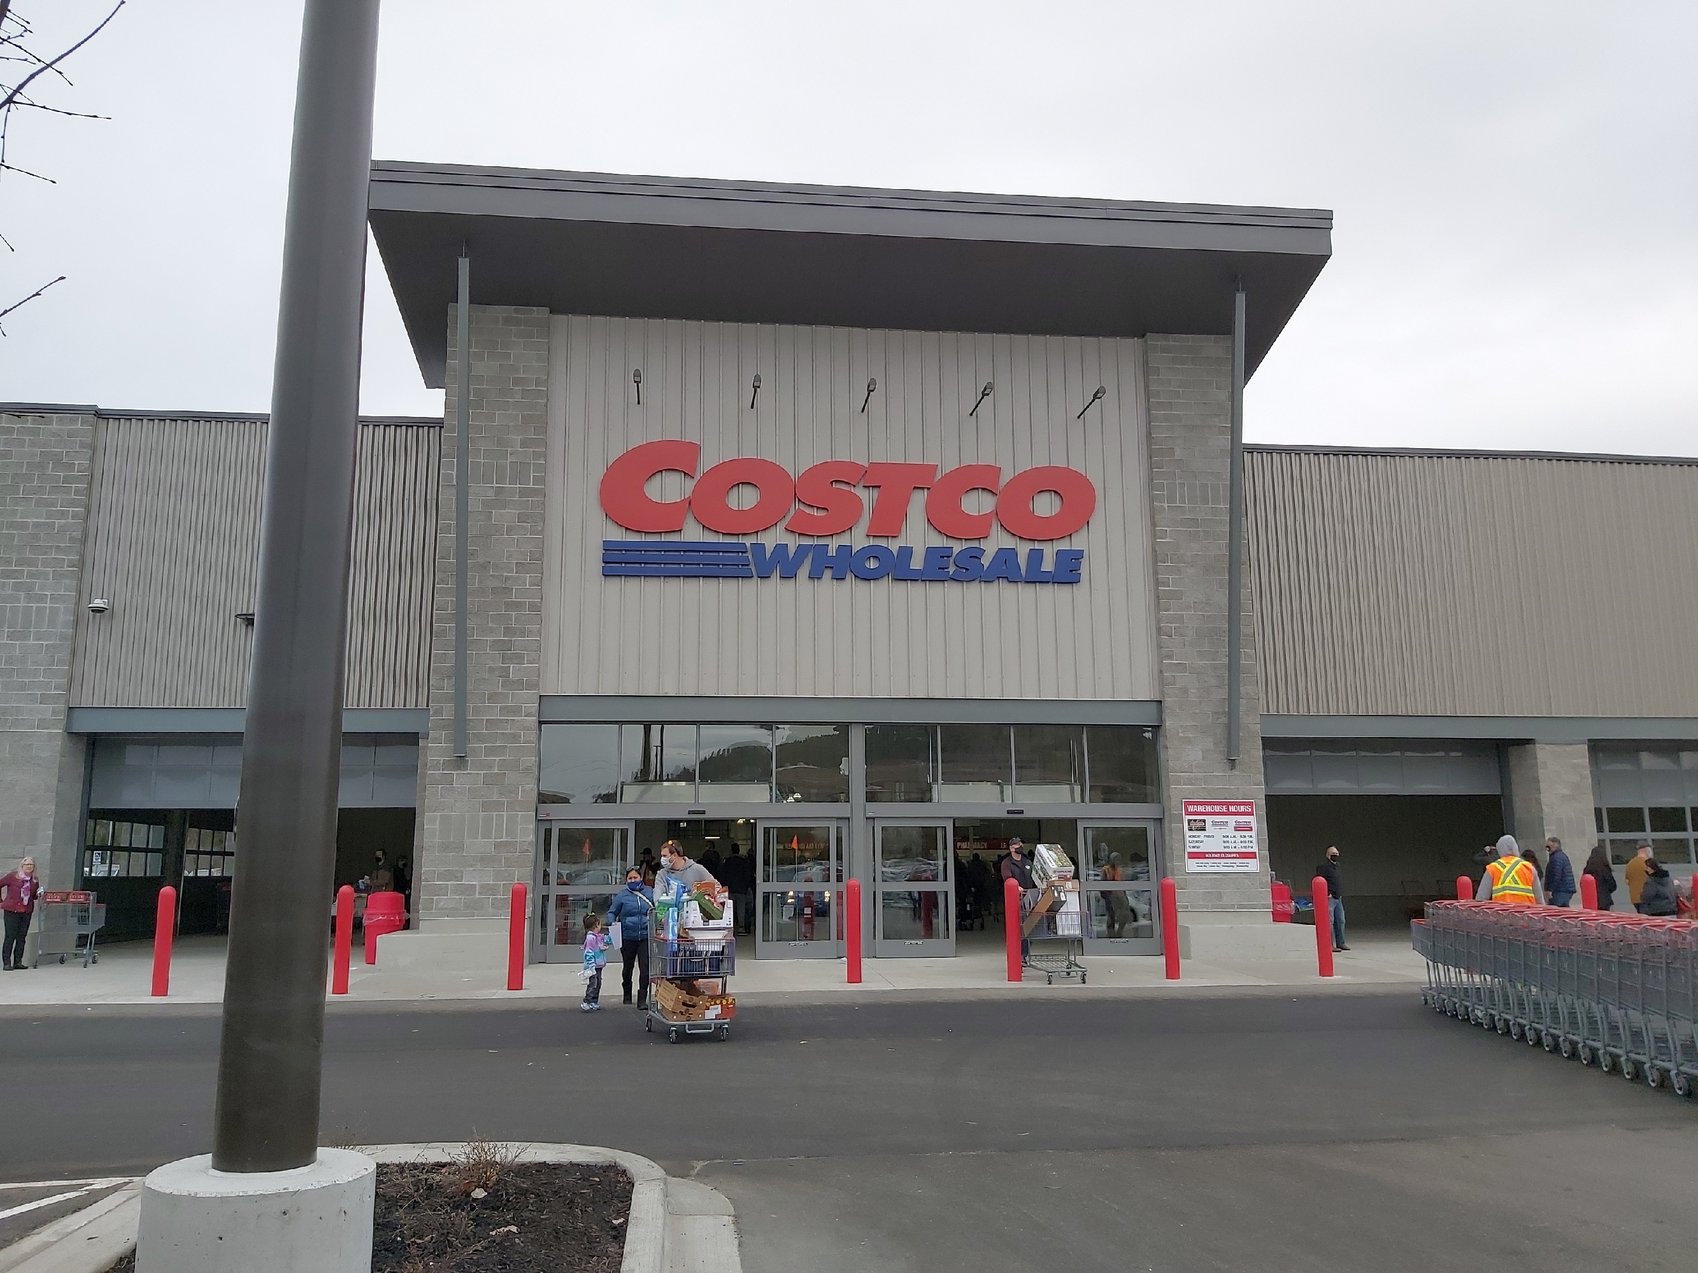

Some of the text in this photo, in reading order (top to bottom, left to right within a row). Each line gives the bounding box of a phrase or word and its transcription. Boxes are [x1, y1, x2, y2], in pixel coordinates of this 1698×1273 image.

[599, 439, 1096, 541] COSTCO
[750, 543, 1085, 584] WHOLESALE
[1186, 804, 1252, 813] WAREHOUSE HOURS
